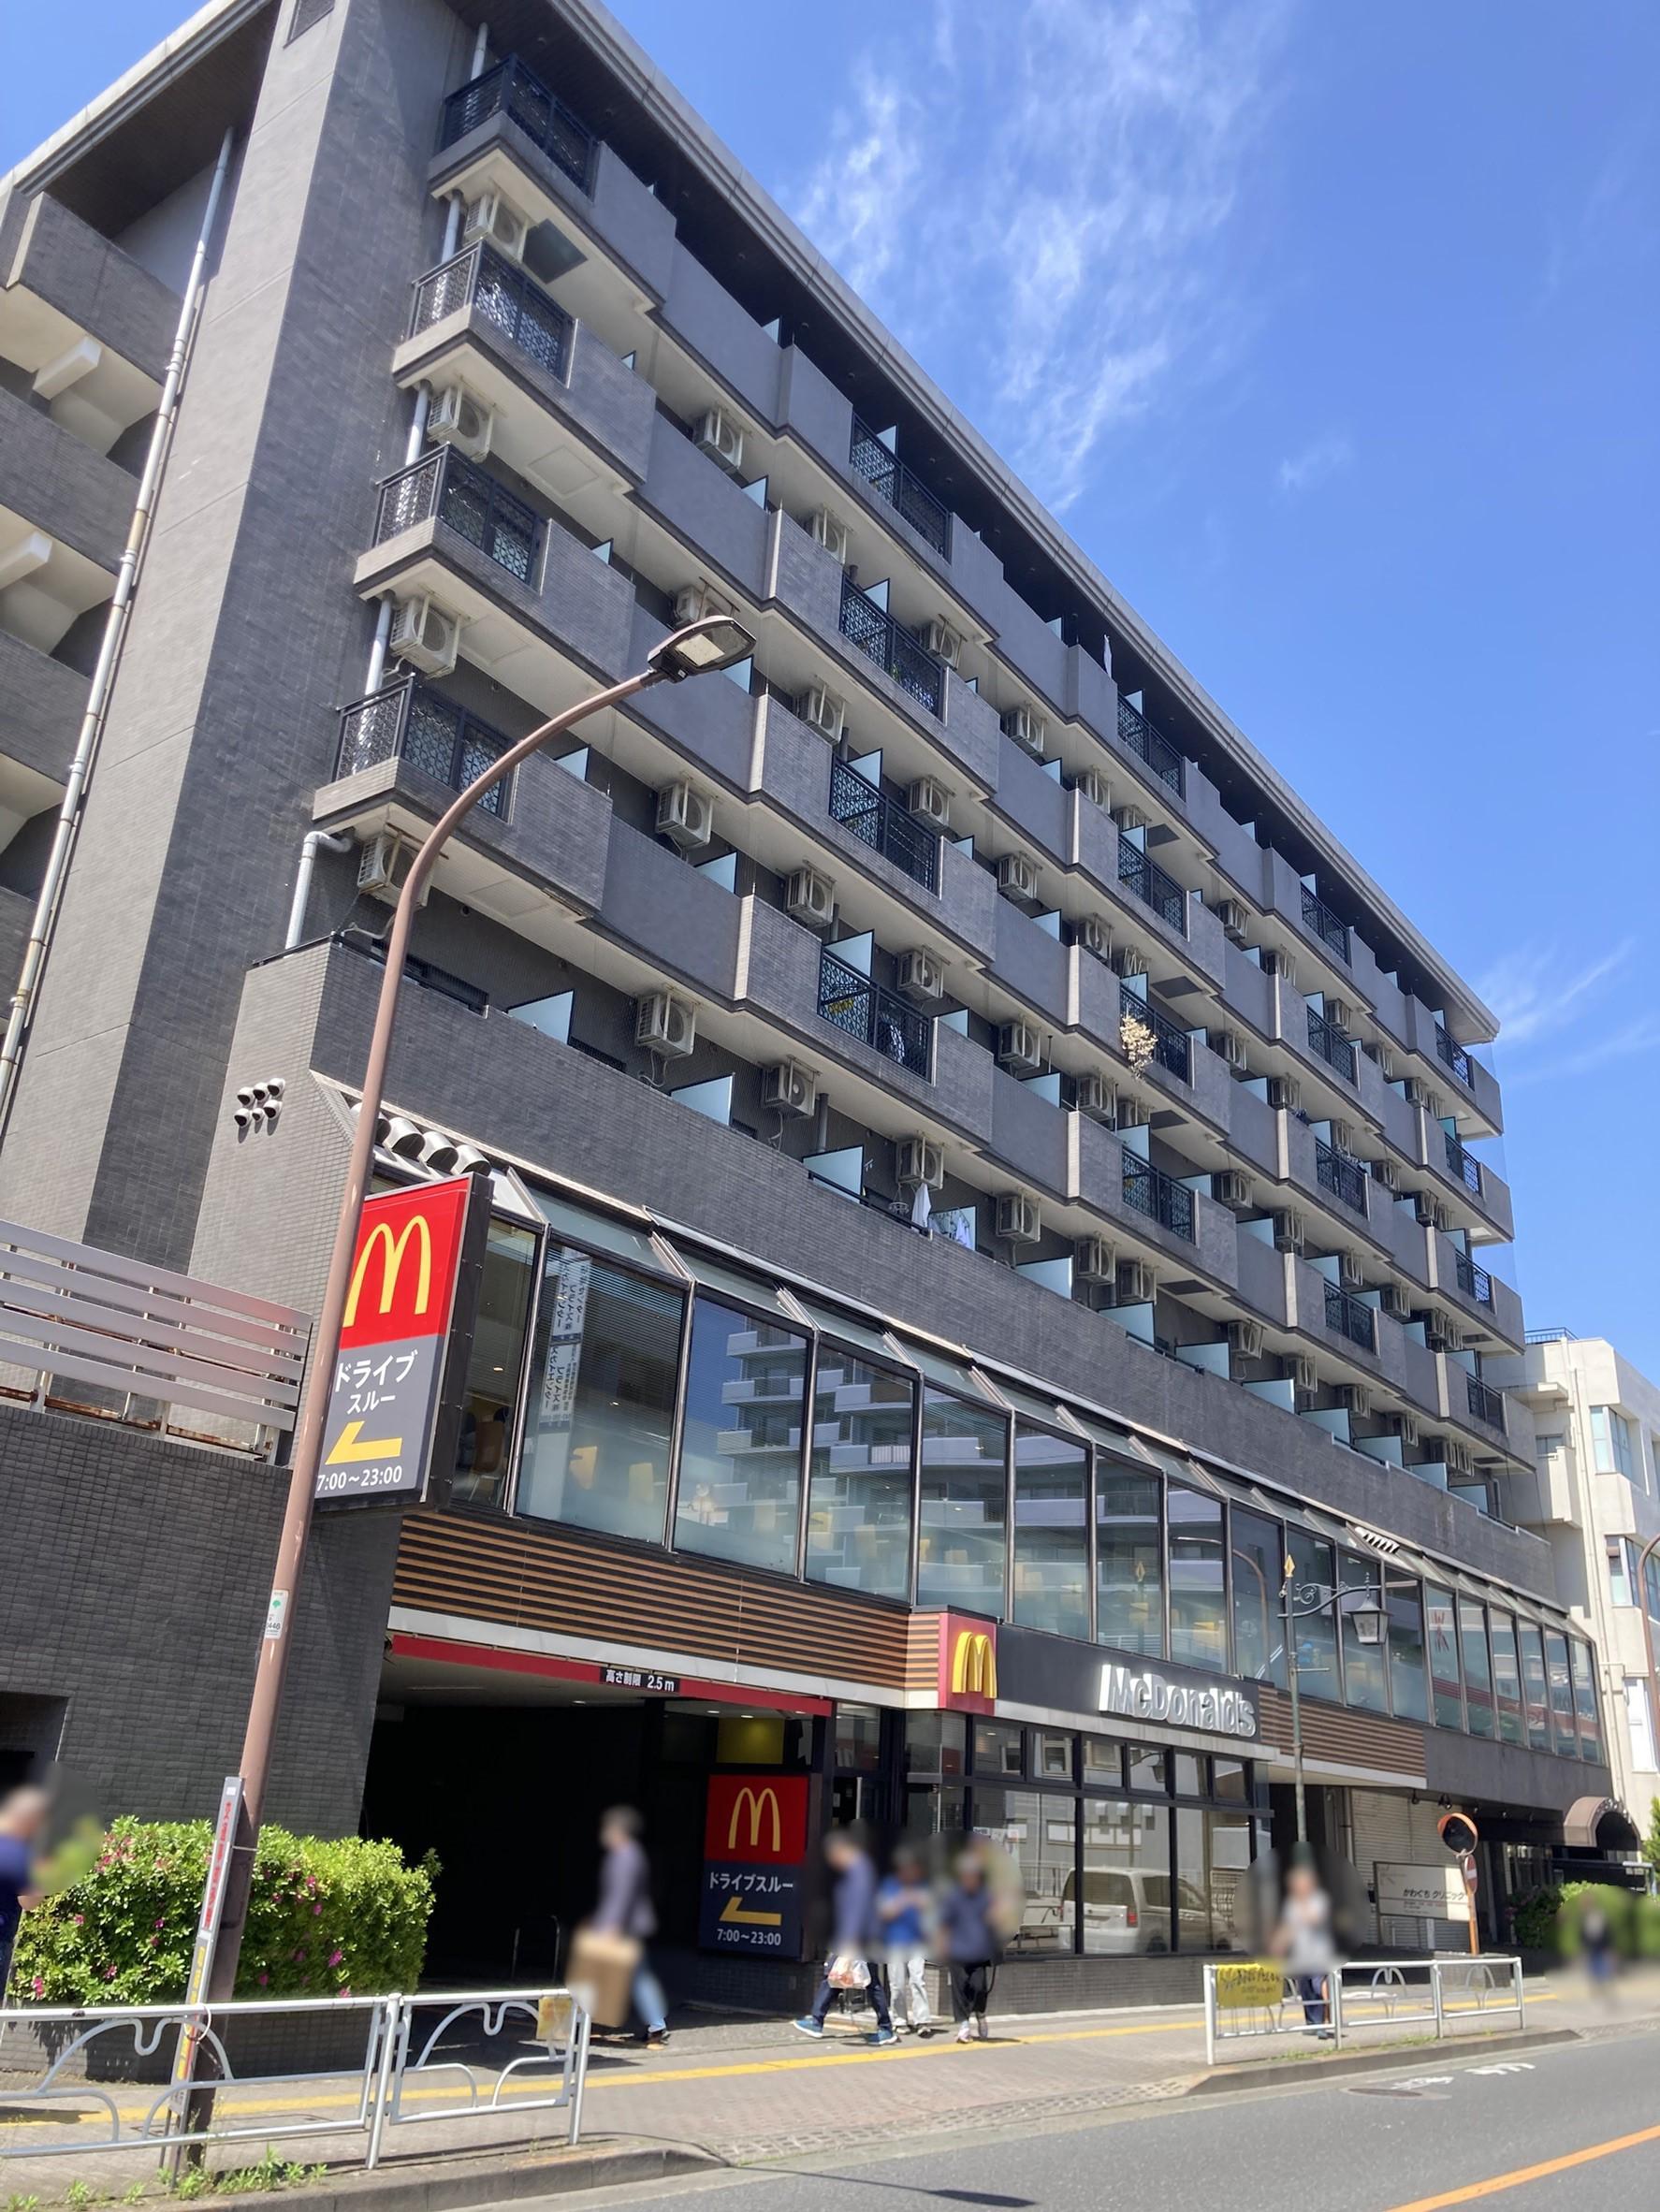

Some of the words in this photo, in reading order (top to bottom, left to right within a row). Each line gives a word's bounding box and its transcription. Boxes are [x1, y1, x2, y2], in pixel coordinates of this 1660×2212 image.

[335, 1349, 418, 1393] ドライブ
[347, 1390, 396, 1415] スルー
[605, 1668, 642, 1687] 高さ制限
[1099, 1664, 1256, 1738] McDonald's
[709, 1871, 794, 1892] ドライブスルー
